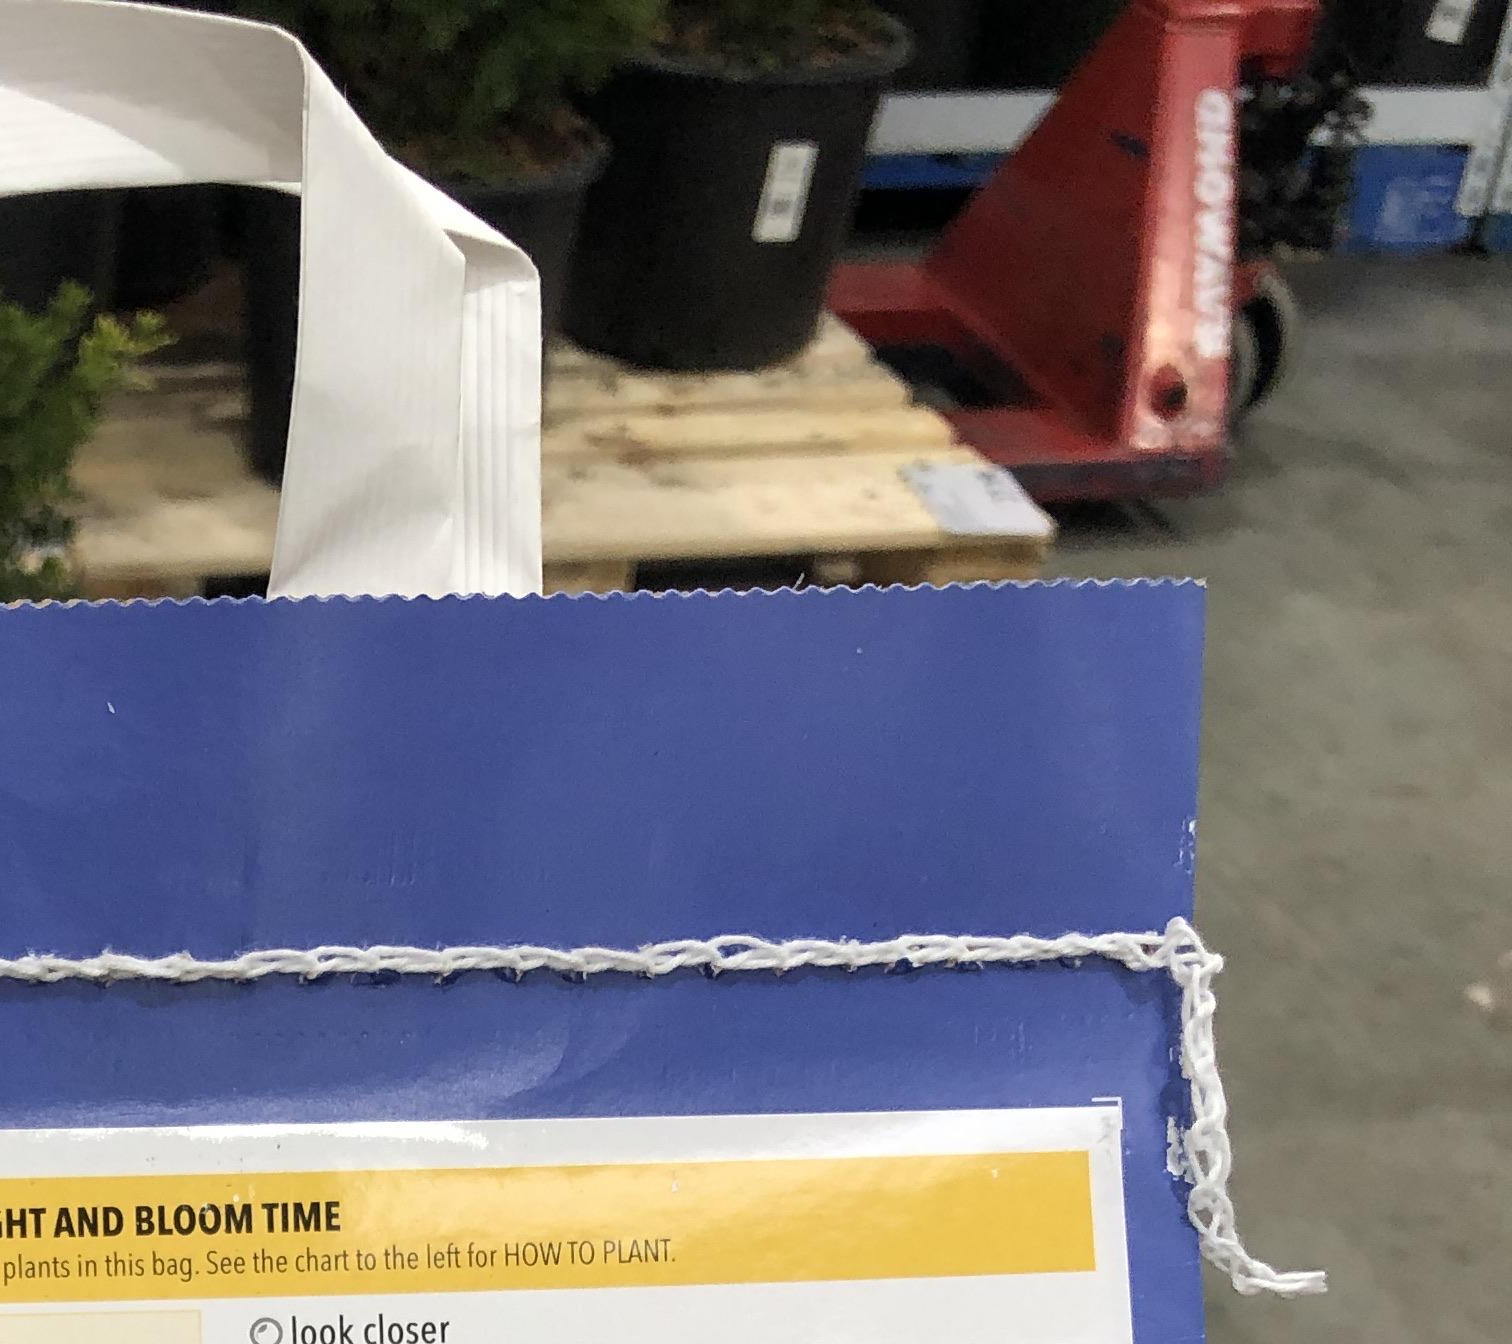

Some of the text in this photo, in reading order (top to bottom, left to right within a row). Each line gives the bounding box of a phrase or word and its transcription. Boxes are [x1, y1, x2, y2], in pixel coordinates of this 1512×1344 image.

[53, 1206, 124, 1238] AND
[135, 1203, 253, 1236] BLOOM
[261, 1200, 341, 1234] TIME
[3, 1253, 70, 1286] plants
[77, 1254, 98, 1278] in
[104, 1251, 145, 1278] this
[152, 1250, 201, 1284] bag.
[206, 1250, 246, 1275] See
[252, 1248, 288, 1274] the
[295, 1246, 350, 1273] chart
[356, 1249, 377, 1272] to
[384, 1244, 419, 1270] the
[426, 1242, 462, 1270] left
[466, 1242, 498, 1268] for
[505, 1241, 565, 1267] HOW
[566, 1240, 596, 1265] TO
[603, 1238, 675, 1265] PLANT.
